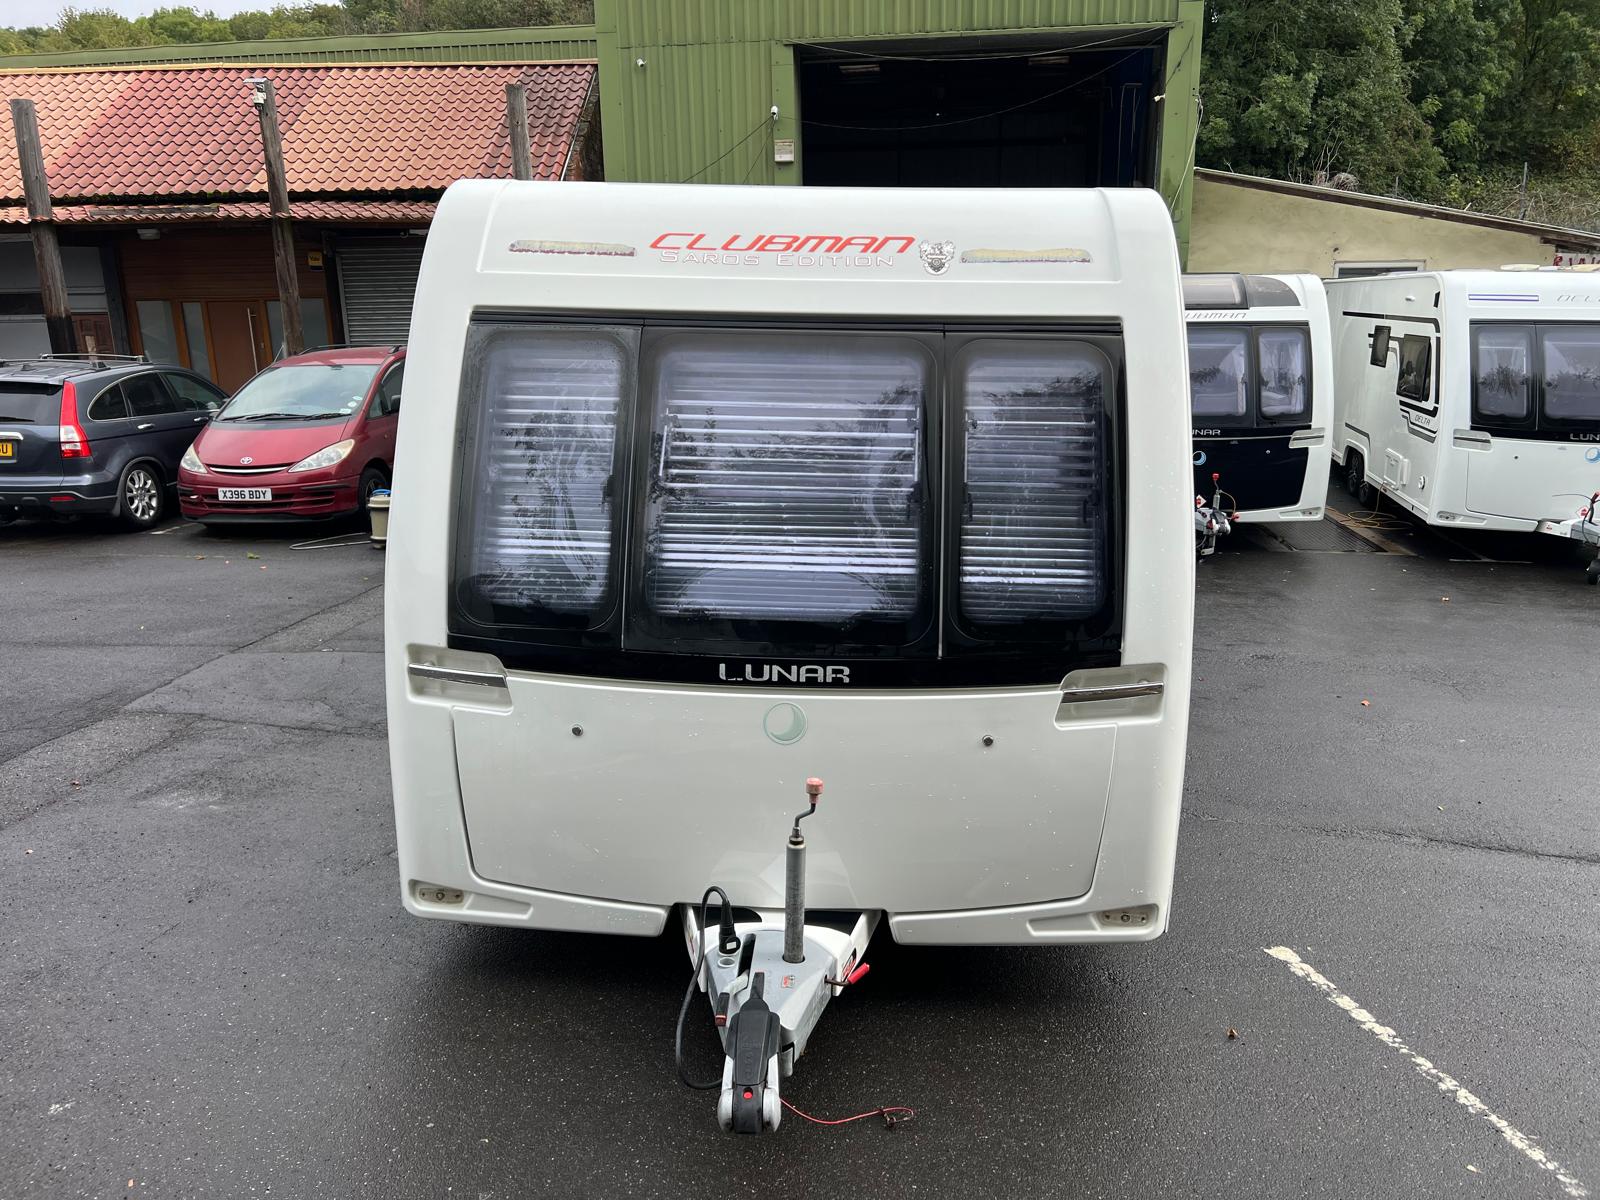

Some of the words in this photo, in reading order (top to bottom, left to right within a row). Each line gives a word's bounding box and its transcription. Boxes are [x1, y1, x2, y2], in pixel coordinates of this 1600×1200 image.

[649, 233, 915, 253] CLUBMAN
[661, 250, 760, 265] SAROS
[776, 253, 894, 267] EDITION
[1569, 433, 1600, 441] LUN
[222, 490, 246, 499] X396
[248, 490, 267, 499] BDY
[718, 663, 850, 683] LUNAR
